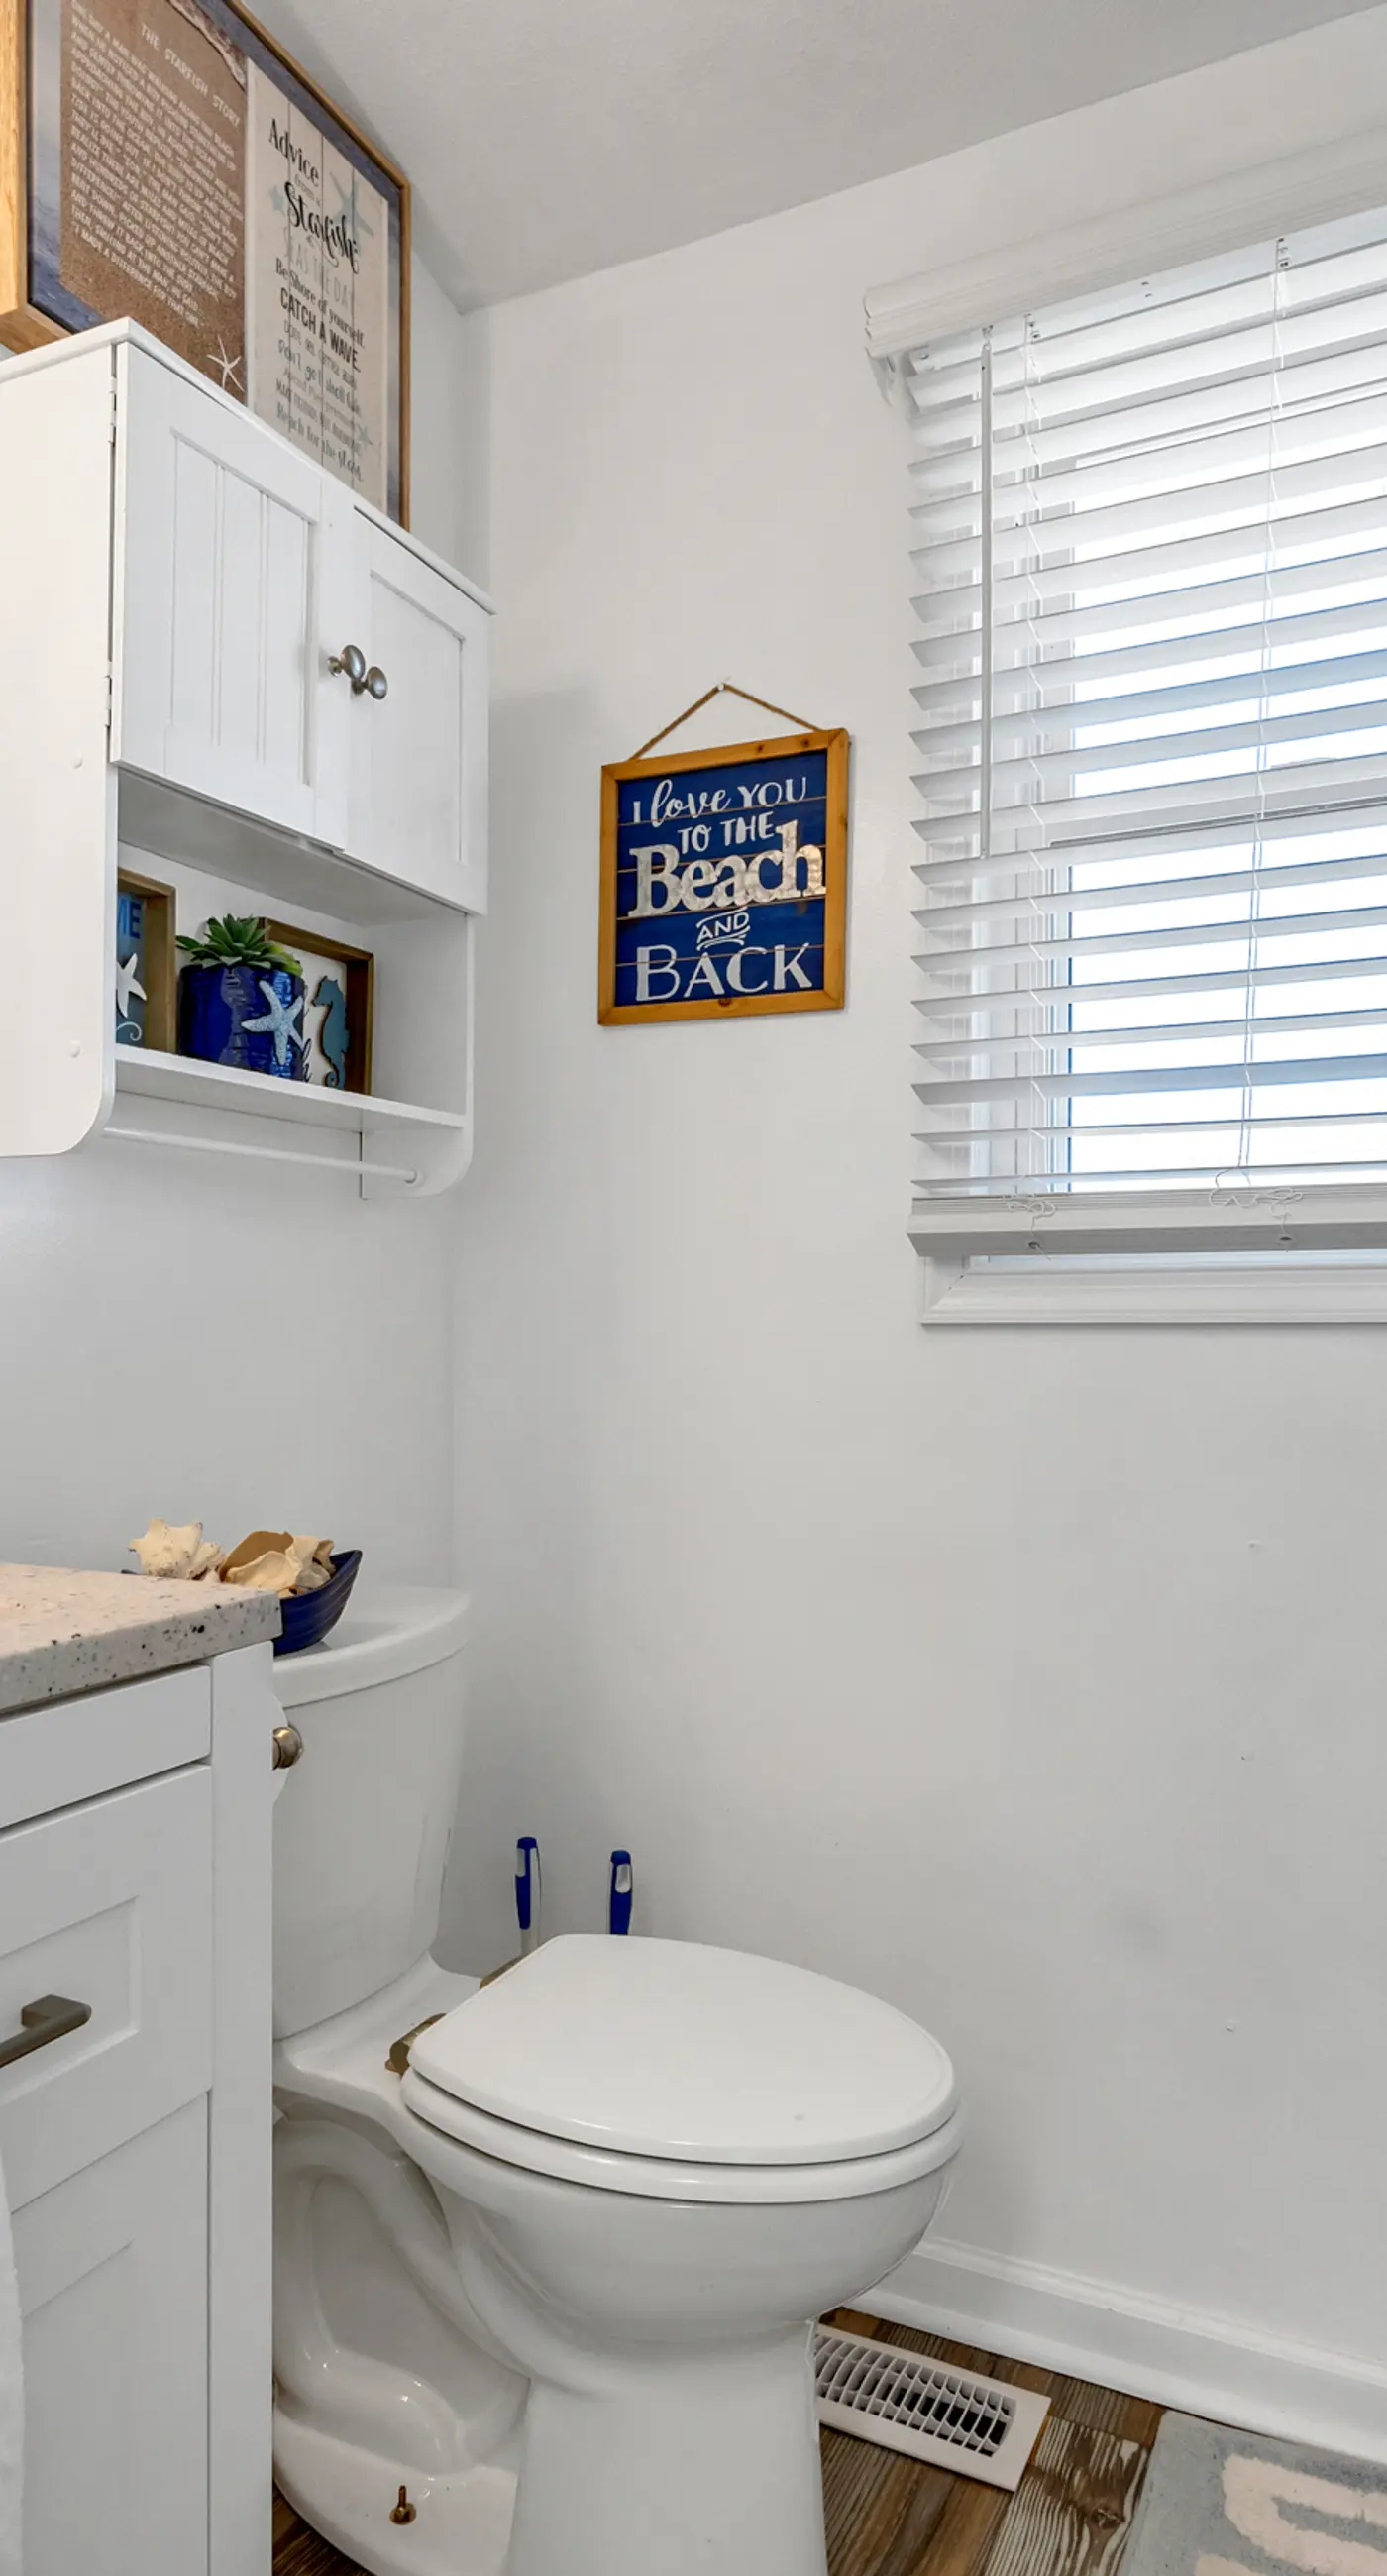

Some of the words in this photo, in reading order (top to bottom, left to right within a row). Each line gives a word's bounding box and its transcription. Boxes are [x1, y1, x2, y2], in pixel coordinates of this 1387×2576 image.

[141, 22, 160, 51] THE
[164, 48, 208, 97] STARFISH
[212, 94, 241, 127] STORY
[268, 118, 320, 187] Advice
[280, 288, 317, 335] CATCH
[319, 321, 327, 344] A
[633, 801, 641, 823] I
[651, 779, 732, 828] love
[737, 776, 807, 809] YOU
[677, 823, 712, 854] TO
[720, 811, 775, 846] THE
[627, 819, 827, 917] Beach
[696, 911, 750, 945] AND
[635, 942, 813, 1002] BACK
